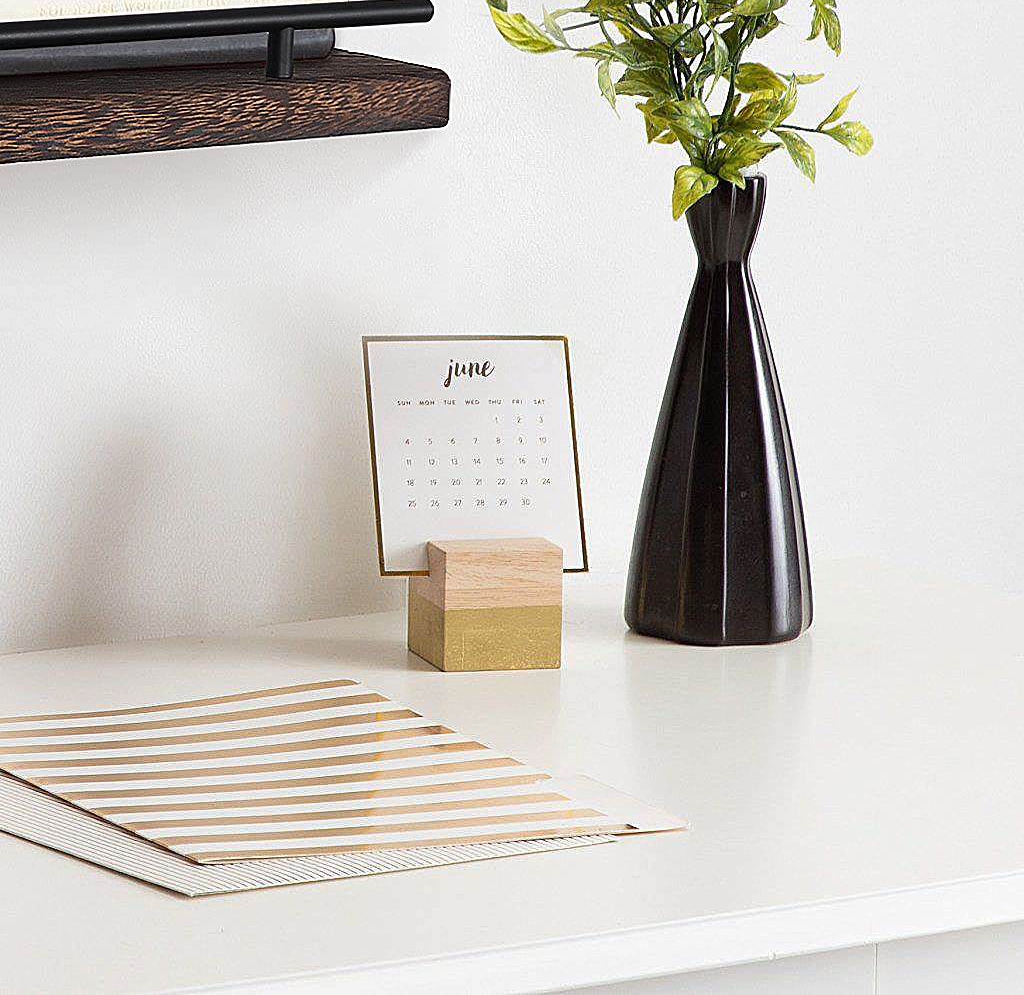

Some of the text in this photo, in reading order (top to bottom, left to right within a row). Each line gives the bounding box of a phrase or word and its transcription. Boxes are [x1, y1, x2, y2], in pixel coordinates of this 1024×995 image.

[443, 359, 495, 387] june
[396, 399, 412, 407] SUN
[463, 398, 481, 406] WED
[487, 398, 503, 406] THU
